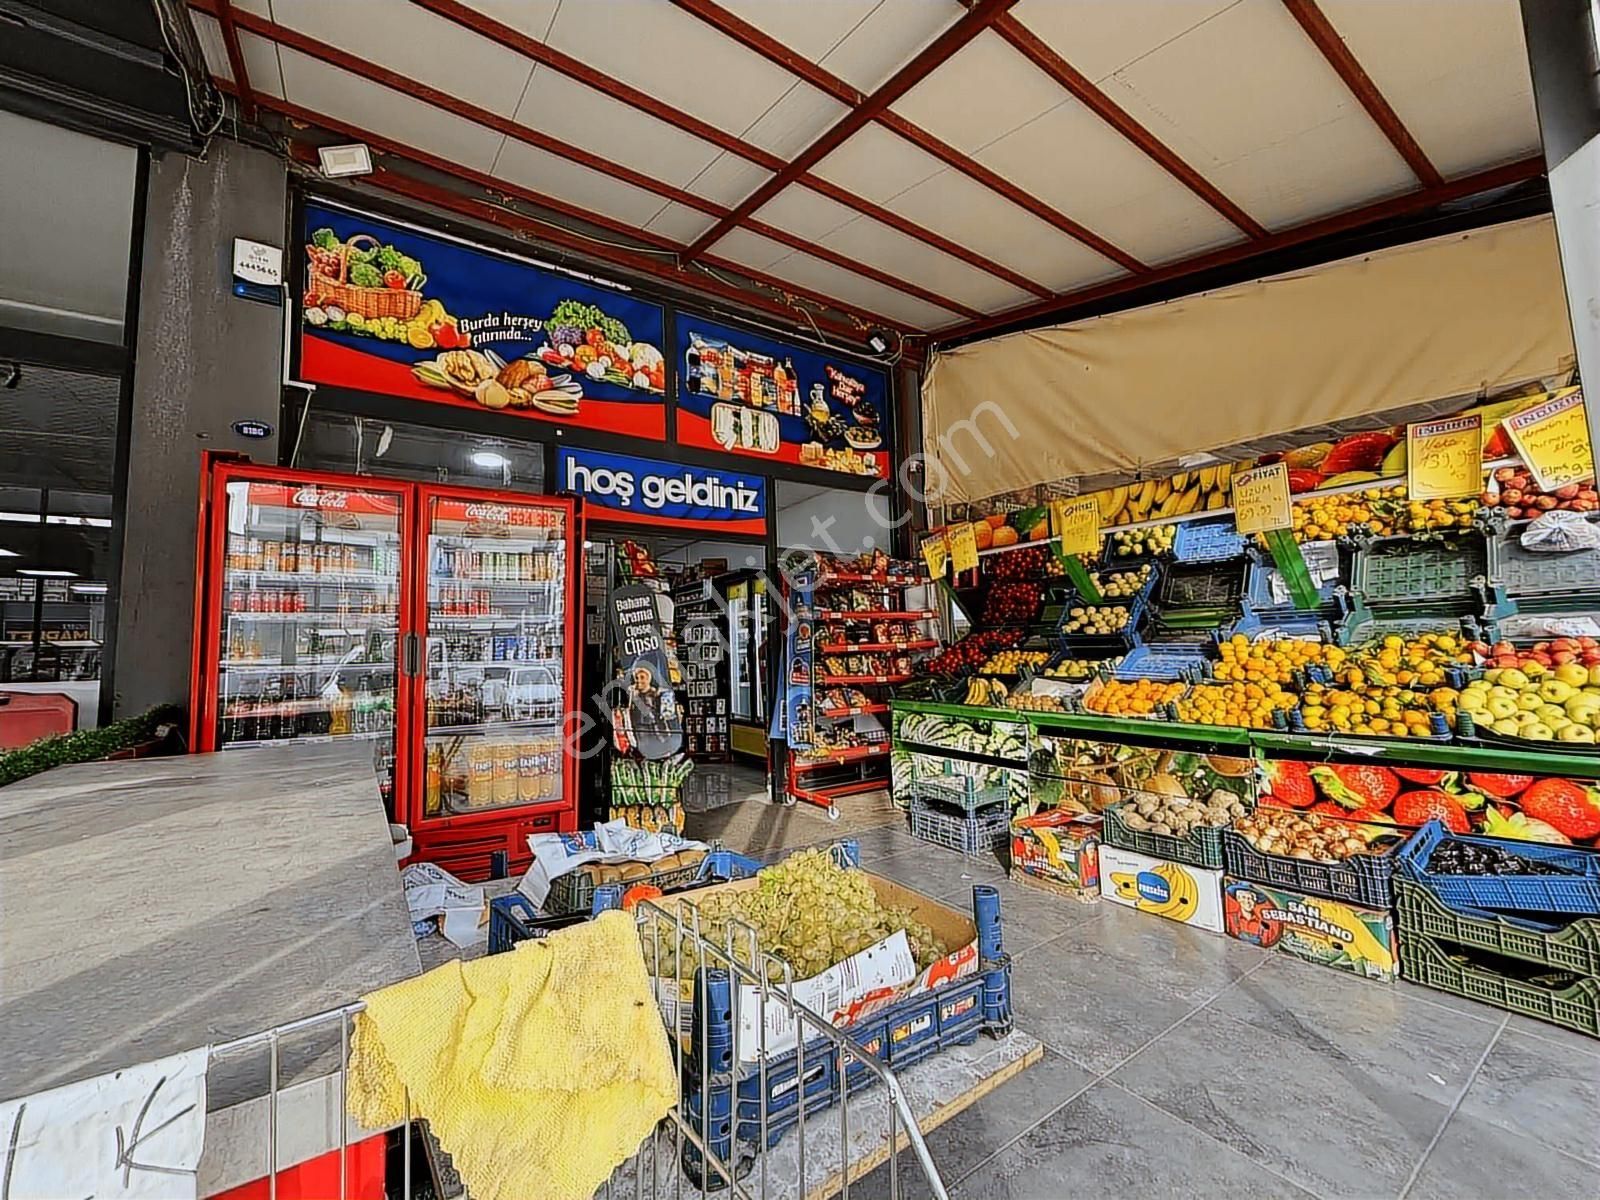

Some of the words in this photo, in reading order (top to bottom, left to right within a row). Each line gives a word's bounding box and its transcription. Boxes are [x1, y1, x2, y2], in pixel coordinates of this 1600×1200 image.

[460, 313, 500, 333] Burda
[503, 312, 543, 332] herşey
[567, 456, 635, 506] hoş
[641, 473, 759, 513] geldiniz
[619, 609, 654, 625] Arama
[1287, 901, 1320, 918] SAN
[1261, 909, 1353, 942] SEBASTIANO
